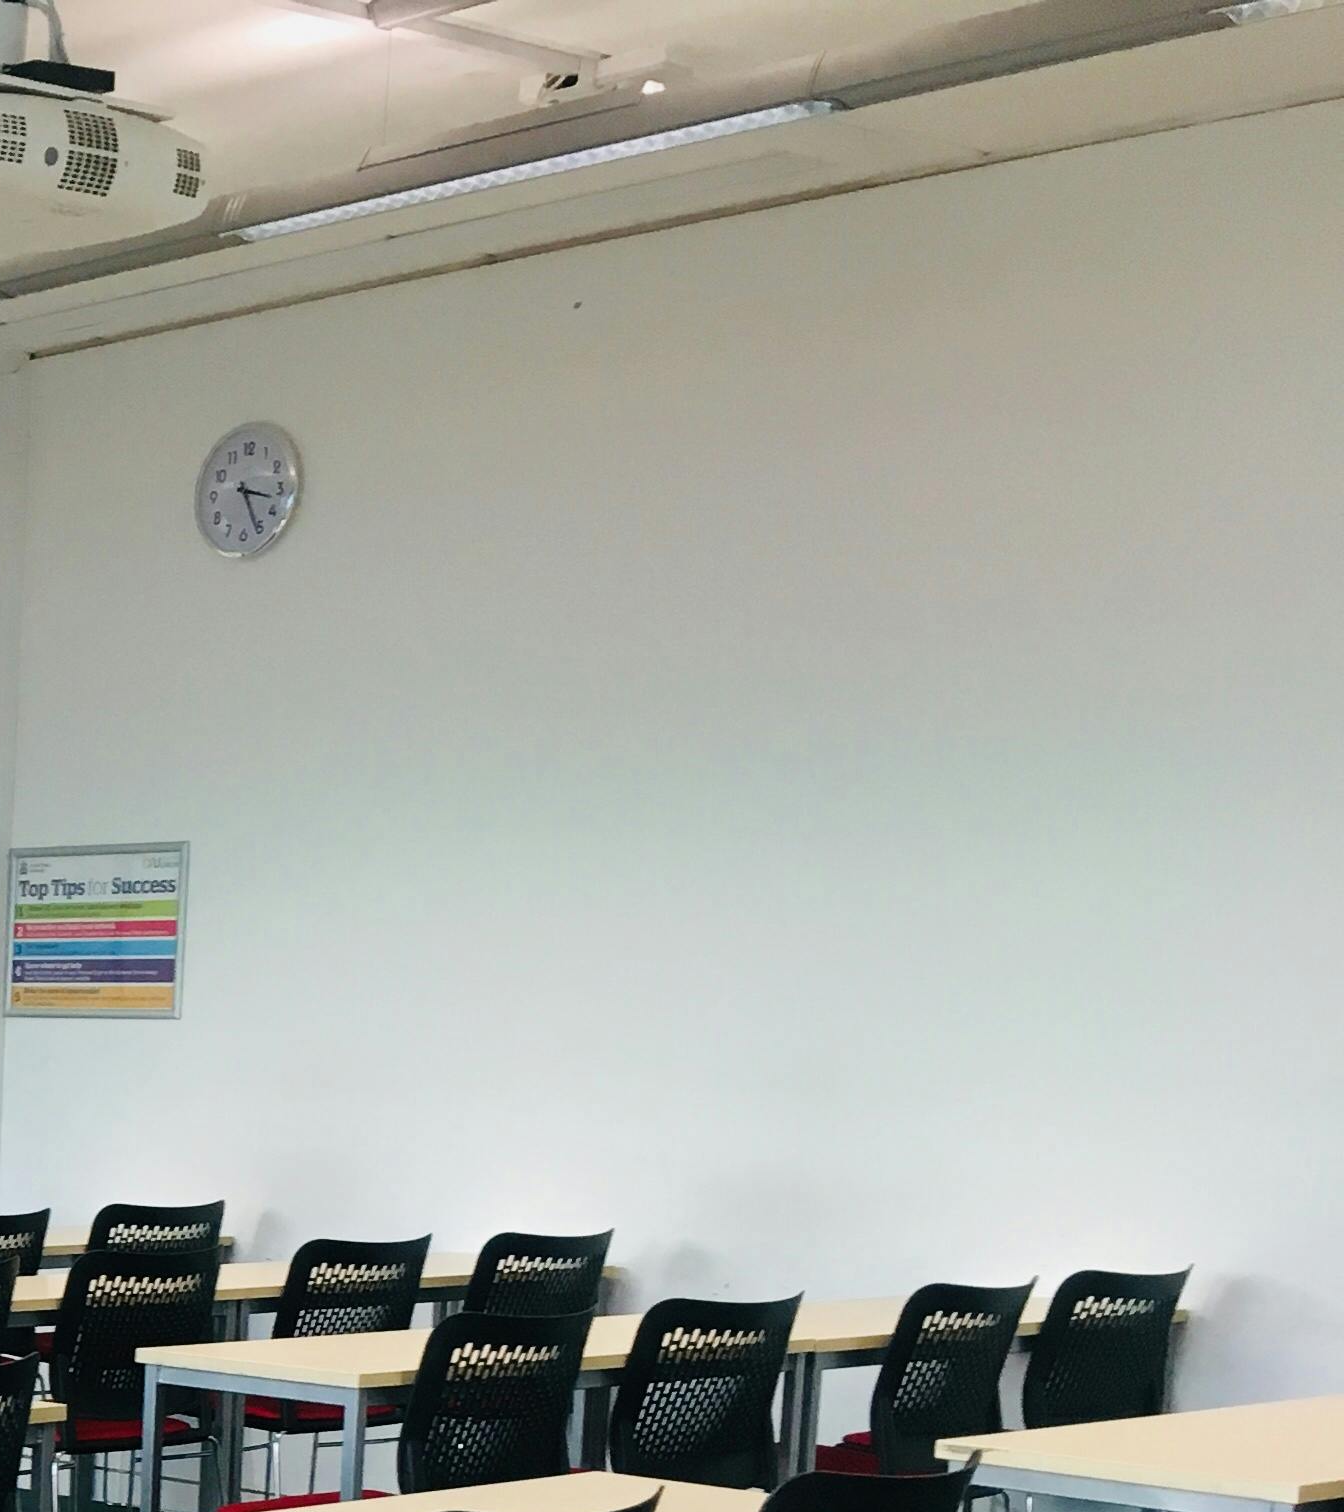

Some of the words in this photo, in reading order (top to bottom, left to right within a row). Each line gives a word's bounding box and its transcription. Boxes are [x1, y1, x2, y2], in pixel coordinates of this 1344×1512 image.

[243, 441, 256, 456] 12
[228, 451, 238, 464] 11
[273, 460, 282, 474] 2
[216, 469, 227, 483] 10
[276, 481, 284, 495] 3
[210, 491, 218, 504] 9
[268, 504, 277, 516] 4
[214, 511, 221, 525] 8
[225, 524, 232, 537] 7
[256, 520, 264, 534] 5
[239, 528, 248, 541] 6
[19, 880, 49, 900] Top
[51, 878, 86, 899] Tips
[111, 877, 177, 895] Success
